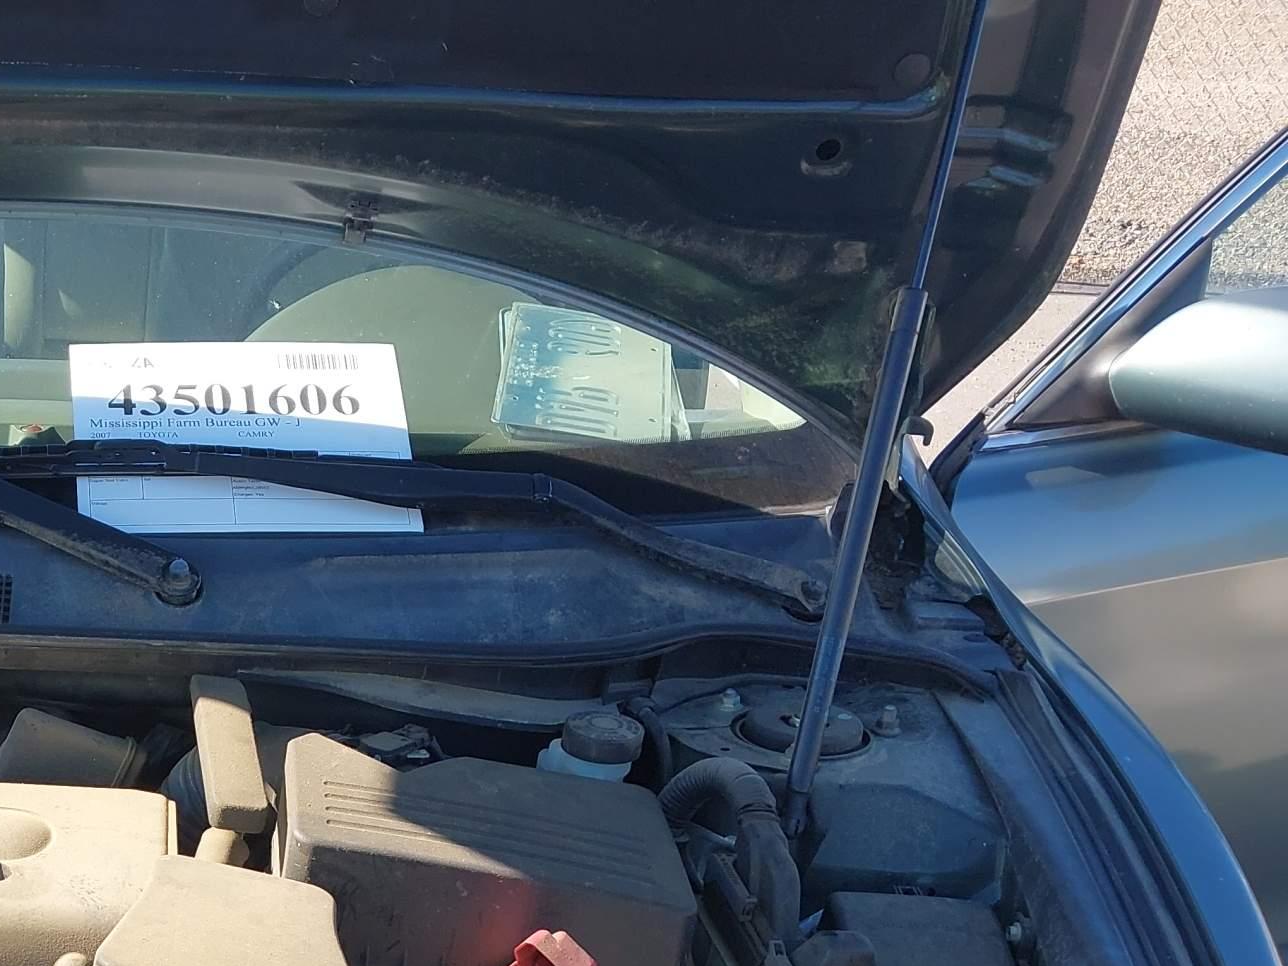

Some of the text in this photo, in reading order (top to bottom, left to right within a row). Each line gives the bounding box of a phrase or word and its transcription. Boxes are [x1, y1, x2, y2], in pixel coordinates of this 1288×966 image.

[107, 383, 360, 416] 43501606
[89, 417, 163, 430] Mississippi
[167, 417, 201, 428] Farm
[205, 417, 251, 427] Bureau
[255, 417, 281, 427] GW
[90, 431, 111, 439] 2007
[137, 431, 179, 439] TOYOTA
